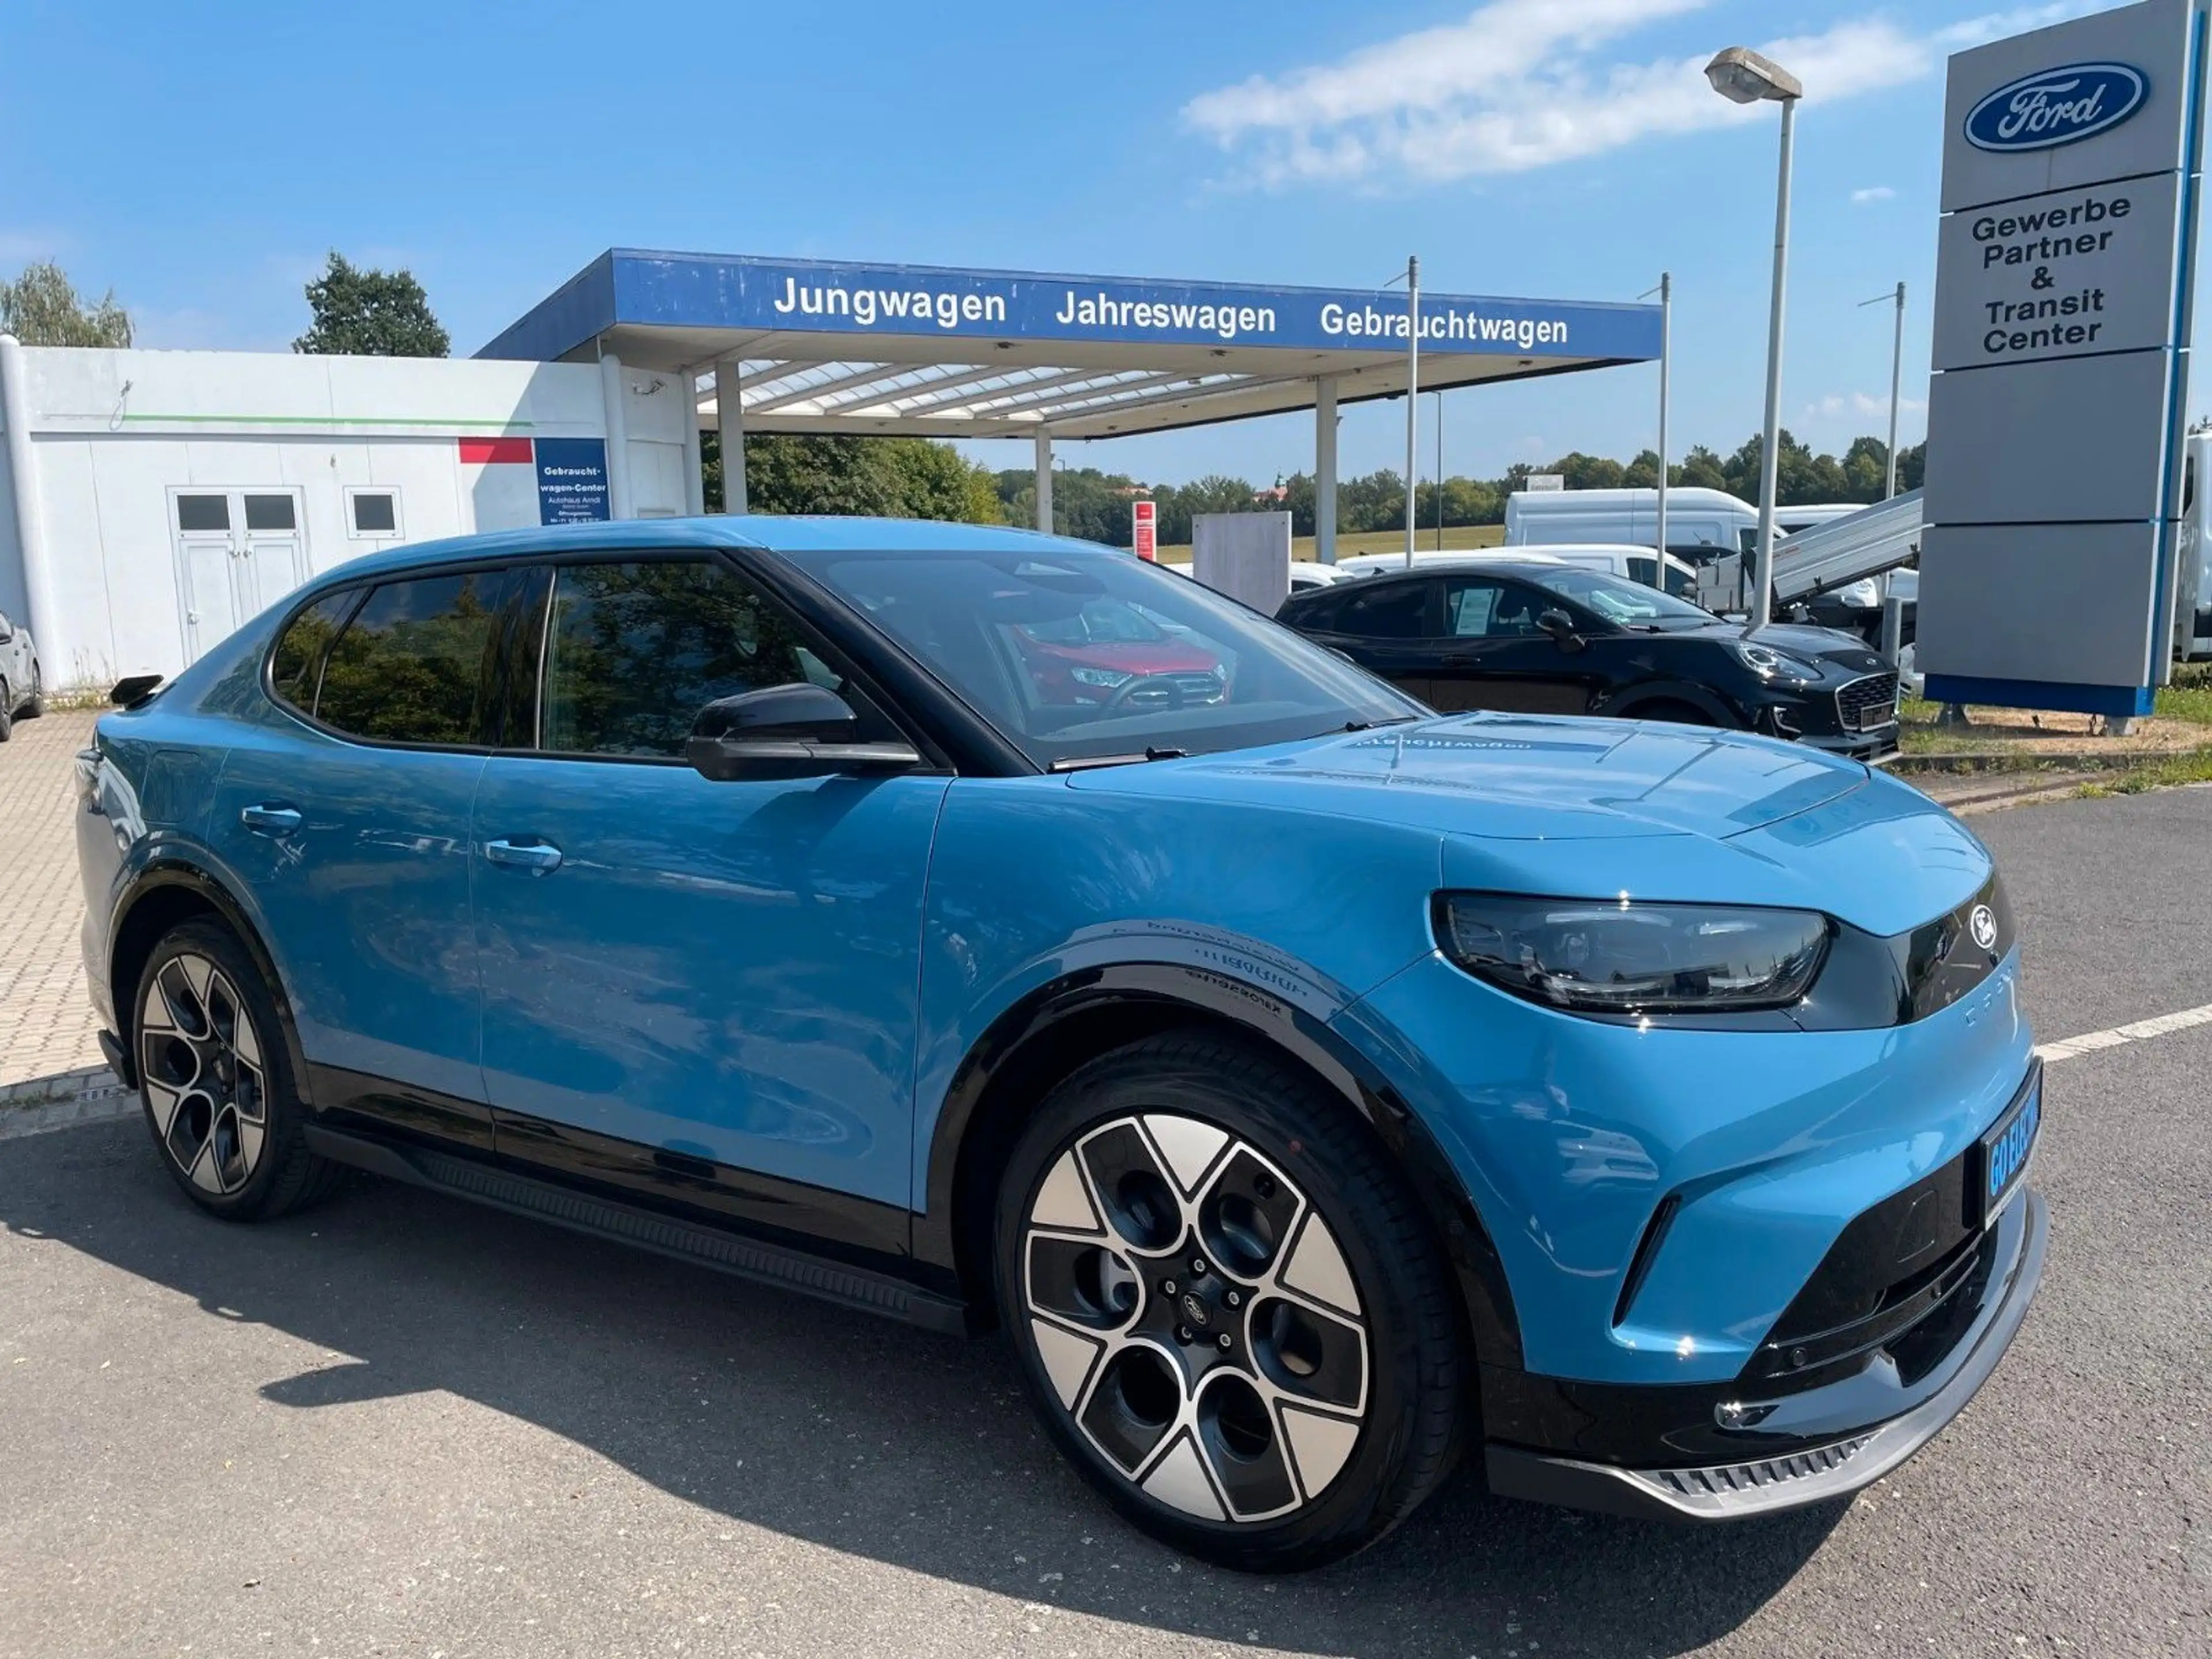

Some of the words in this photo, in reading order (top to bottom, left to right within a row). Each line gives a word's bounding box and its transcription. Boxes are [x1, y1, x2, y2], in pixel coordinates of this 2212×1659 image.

[1997, 78, 2107, 139] Ford
[1972, 197, 2131, 241] Gewerbe
[1983, 230, 2112, 269] Partner
[2031, 266, 2054, 290] &
[774, 277, 1006, 328] Jungwagen
[1056, 291, 1275, 338] Jahreswagen
[1320, 303, 1567, 350] Gebrauchtwagen
[1985, 289, 2104, 324] Transit
[1983, 323, 2103, 354] Center
[540, 484, 607, 493] wagen-Center
[544, 467, 601, 475] Gebraucht-
[1990, 1135, 2008, 1197] GO
